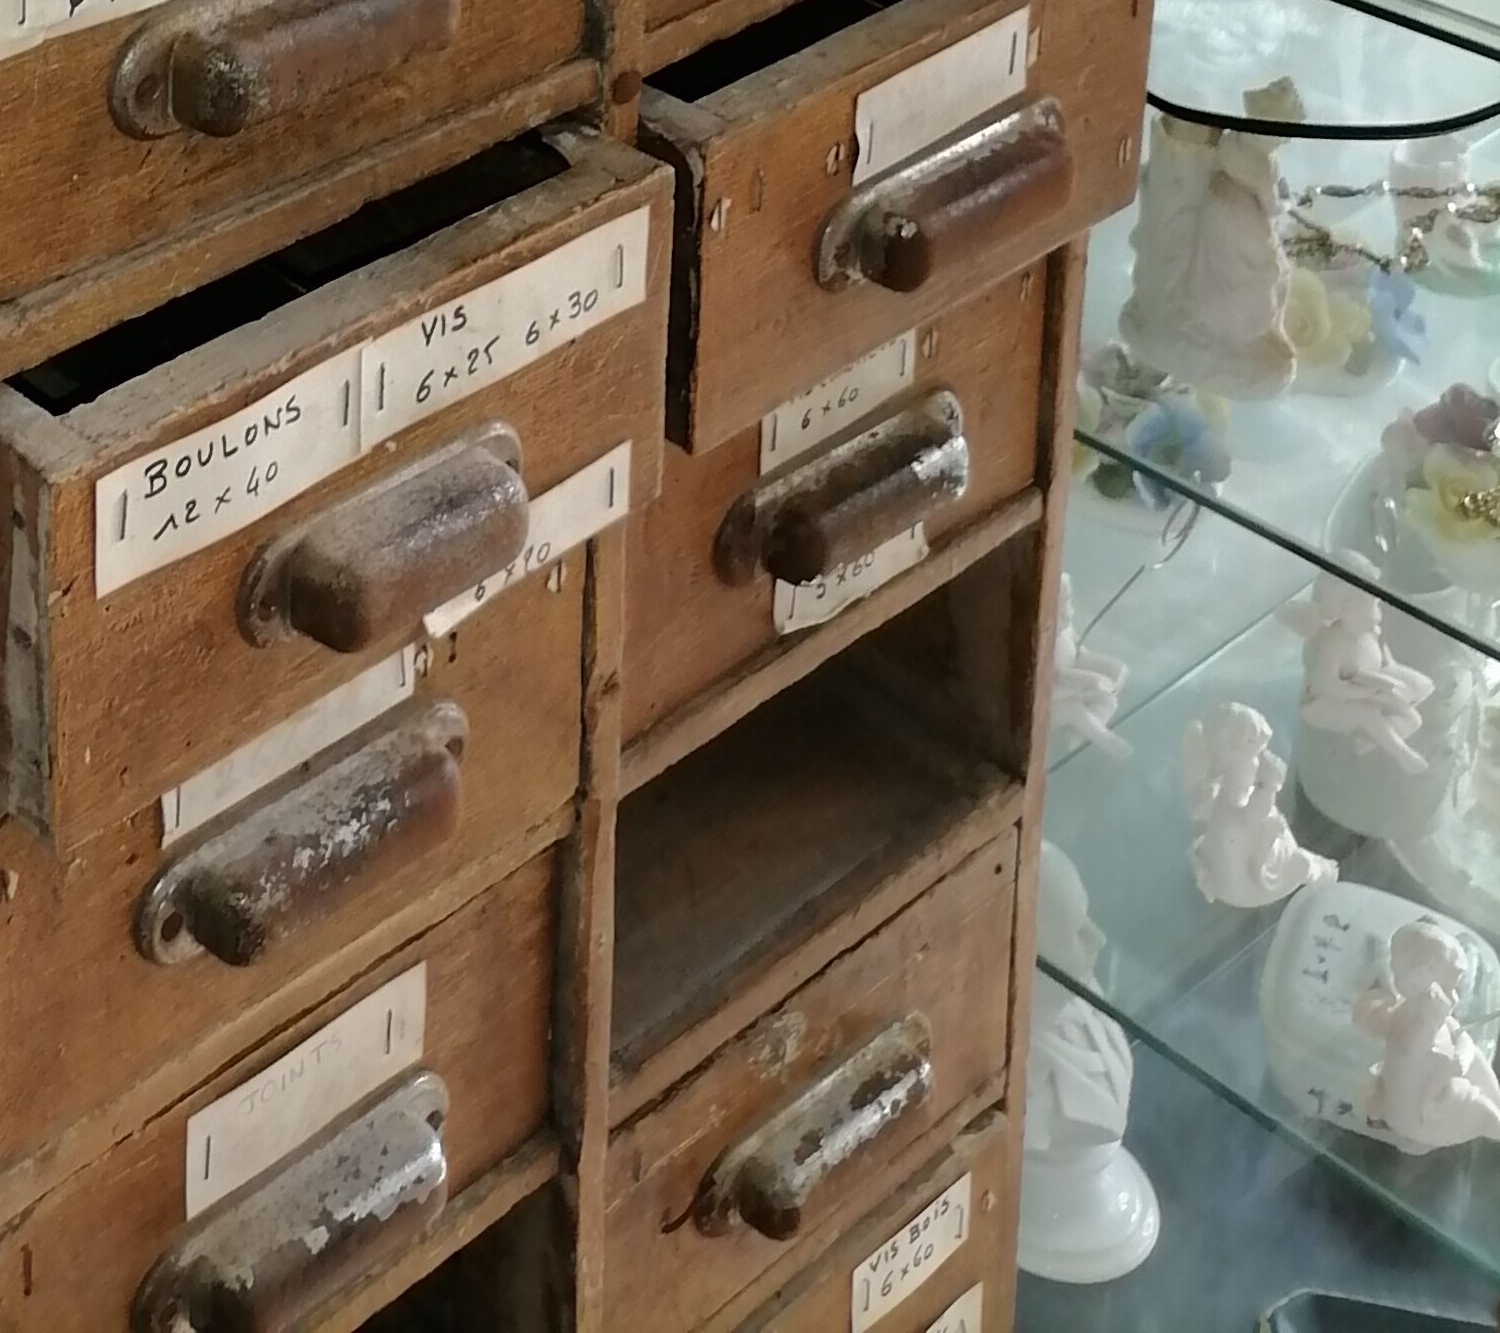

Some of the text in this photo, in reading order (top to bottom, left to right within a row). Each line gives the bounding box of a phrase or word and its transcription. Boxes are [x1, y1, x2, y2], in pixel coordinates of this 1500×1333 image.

[421, 304, 468, 347] VIS
[143, 394, 302, 500] BOULONS
[868, 1240, 899, 1273] VIS
